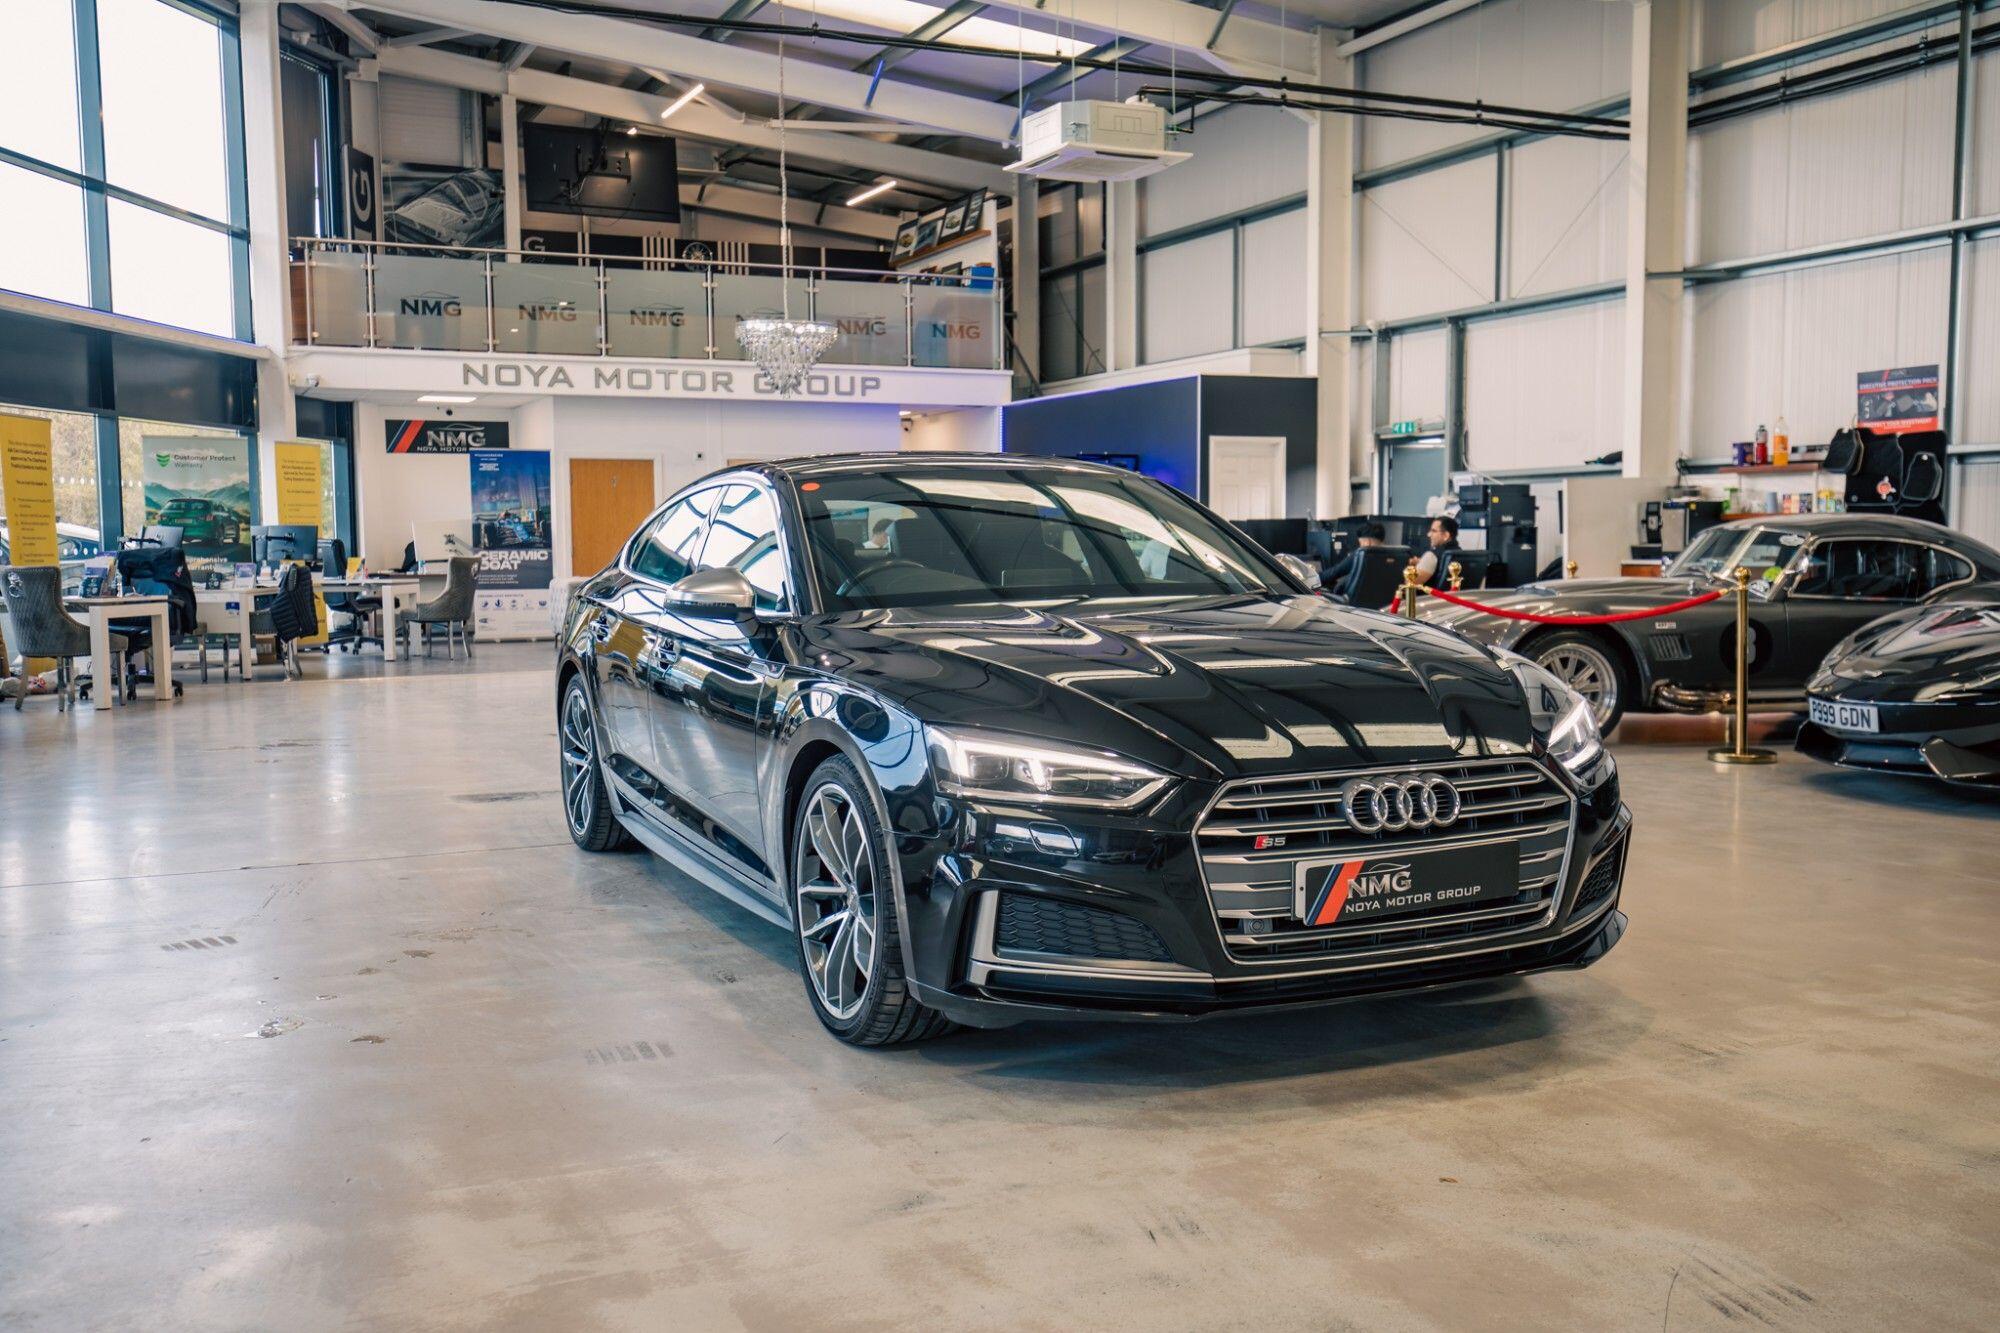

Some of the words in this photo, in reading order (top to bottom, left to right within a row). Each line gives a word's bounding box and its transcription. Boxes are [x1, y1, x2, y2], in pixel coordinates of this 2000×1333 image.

[400, 299, 462, 316] NMG
[518, 304, 577, 321] NMG
[630, 310, 685, 327] NMG
[836, 319, 886, 336] NMG
[932, 323, 981, 339] NMG
[463, 363, 574, 388] NOYA
[594, 367, 734, 393] MOTOR
[753, 373, 880, 397] GOUP
[427, 431, 486, 447] NMG
[480, 550, 549, 560] CERAMIC
[1812, 700, 1836, 724] P999
[1839, 707, 1872, 729] GDN
[1263, 837, 1286, 847] S5
[1346, 871, 1412, 900] NMG
[1345, 900, 1381, 914] NOYA
[1386, 892, 1432, 906] MOTOR
[1437, 885, 1482, 900] GROUP
